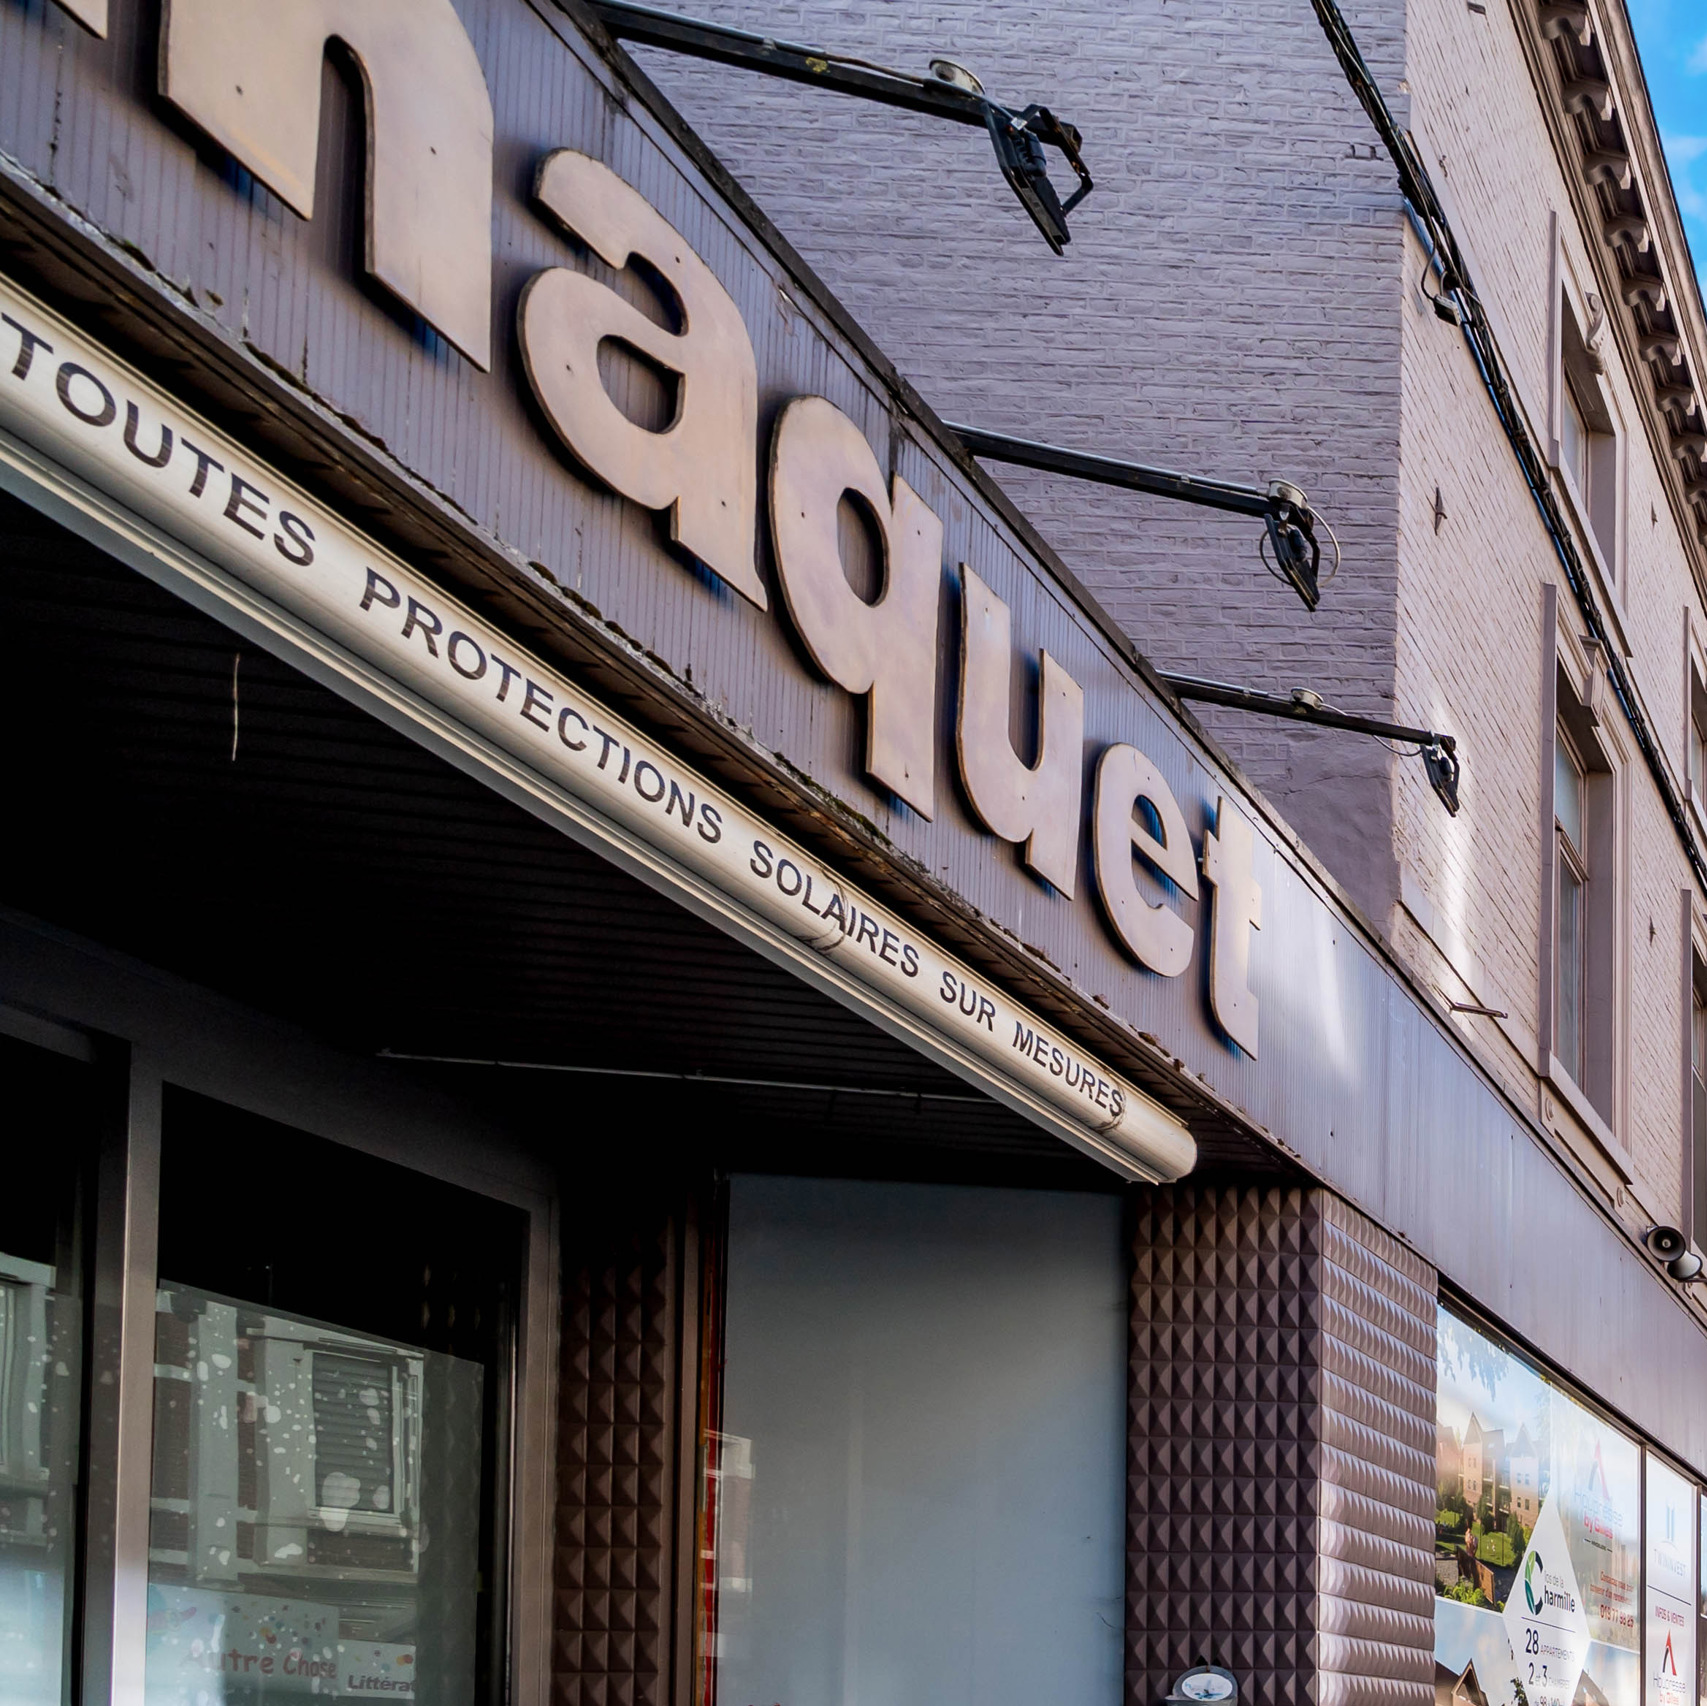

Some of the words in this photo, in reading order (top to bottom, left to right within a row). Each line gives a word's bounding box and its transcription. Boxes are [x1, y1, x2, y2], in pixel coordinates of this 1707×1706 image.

[1, 311, 316, 567] TOUTES
[359, 566, 722, 846] PROTECTIONS
[750, 839, 919, 978] SOLAIRES
[939, 970, 996, 1032] SUR
[1011, 1020, 1124, 1117] MESURES
[1525, 1628, 1539, 1656] 28
[282, 1653, 338, 1680] Chose
[1528, 1662, 1535, 1686] 2
[1541, 1664, 1548, 1688] 3
